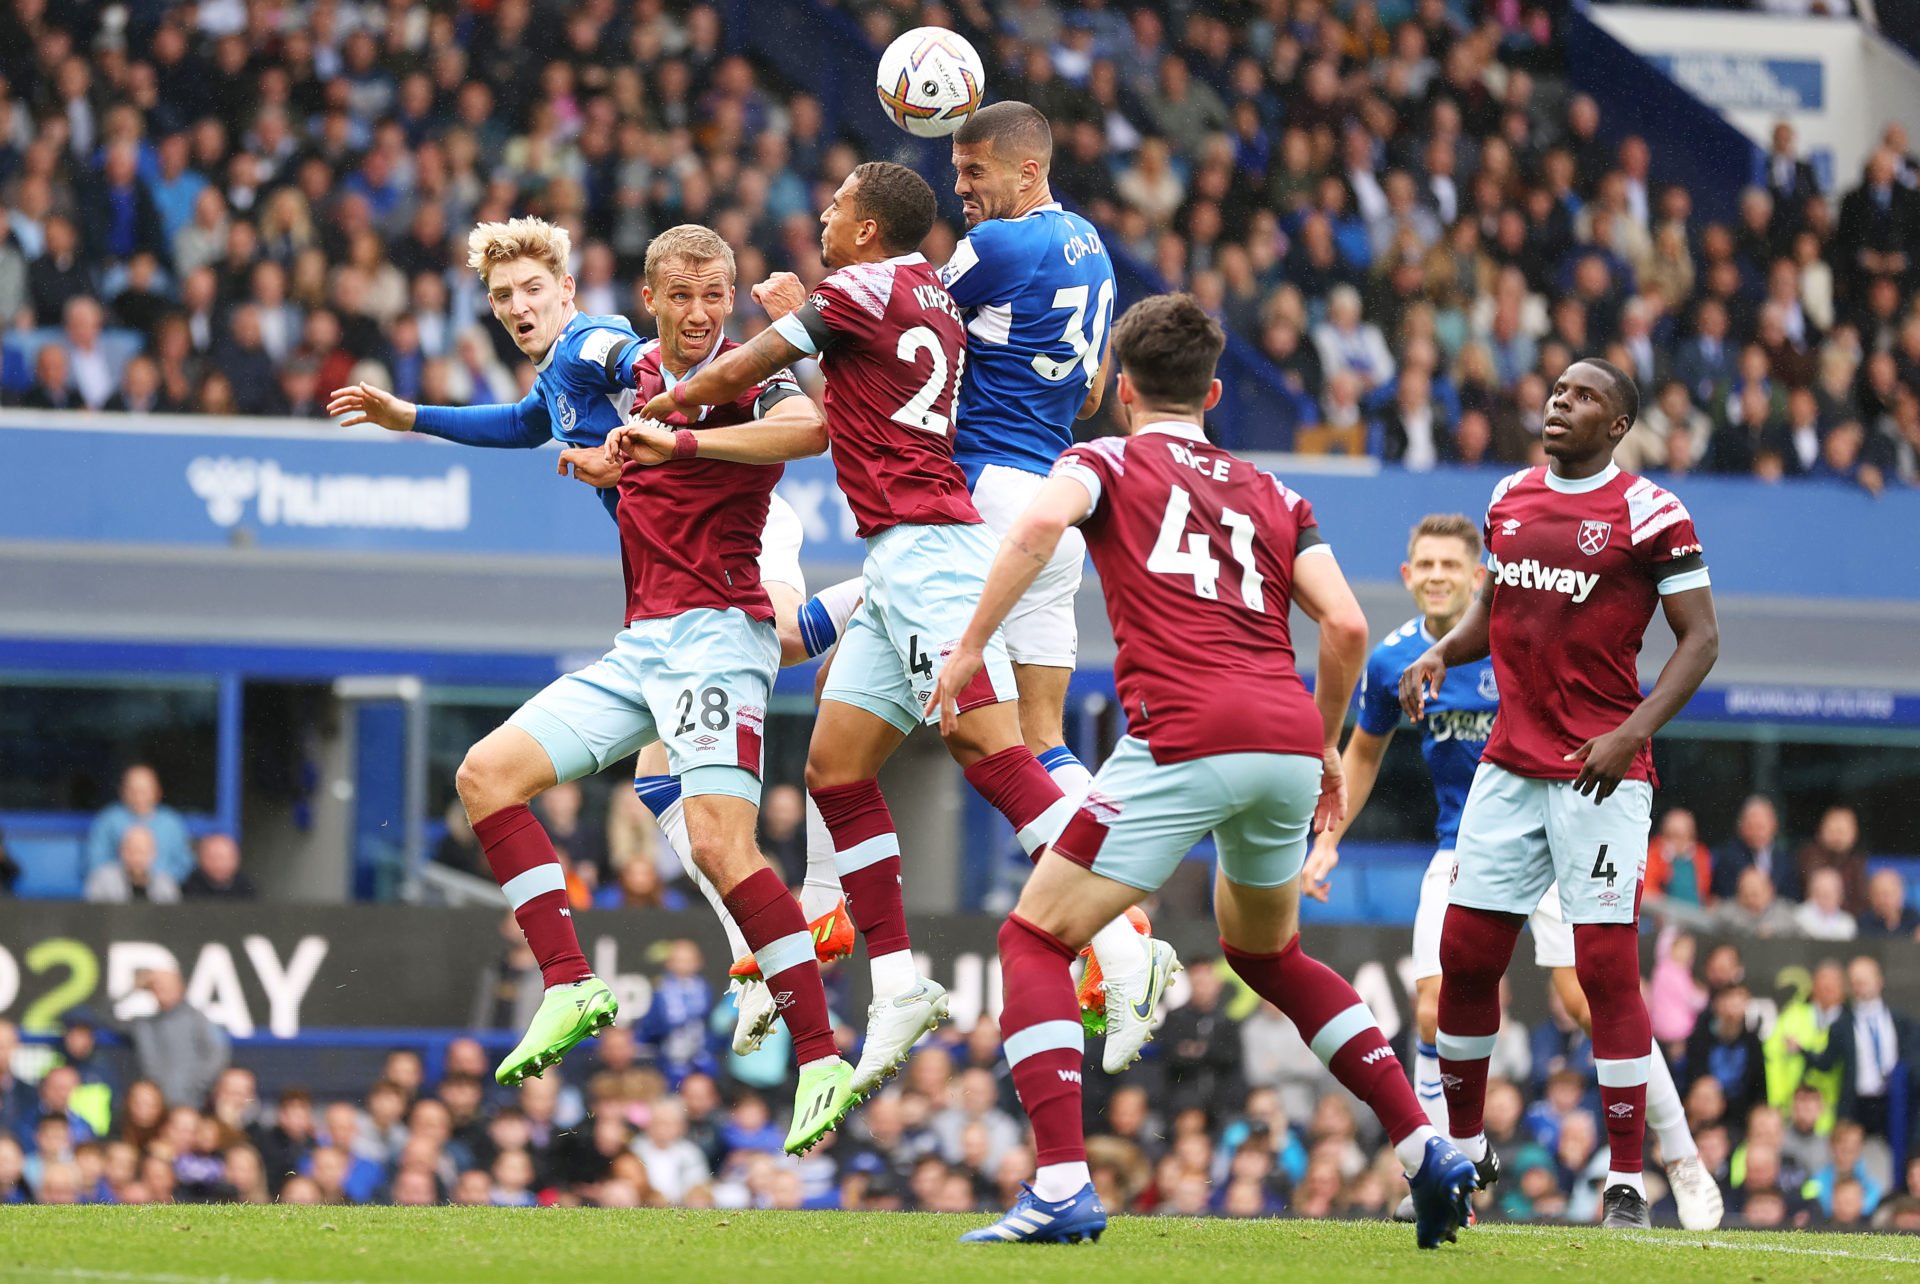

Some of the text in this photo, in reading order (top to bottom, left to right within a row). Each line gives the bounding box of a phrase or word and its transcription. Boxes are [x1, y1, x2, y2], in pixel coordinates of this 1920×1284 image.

[1064, 231, 1106, 266] COAD
[1031, 277, 1114, 390] 30
[890, 326, 966, 438] 2
[1166, 442, 1231, 482] RICE
[1146, 484, 1266, 614] 41
[1495, 553, 1600, 604] betway
[674, 686, 730, 738] 28
[695, 744, 716, 752] umbro
[1591, 844, 1618, 888] 4
